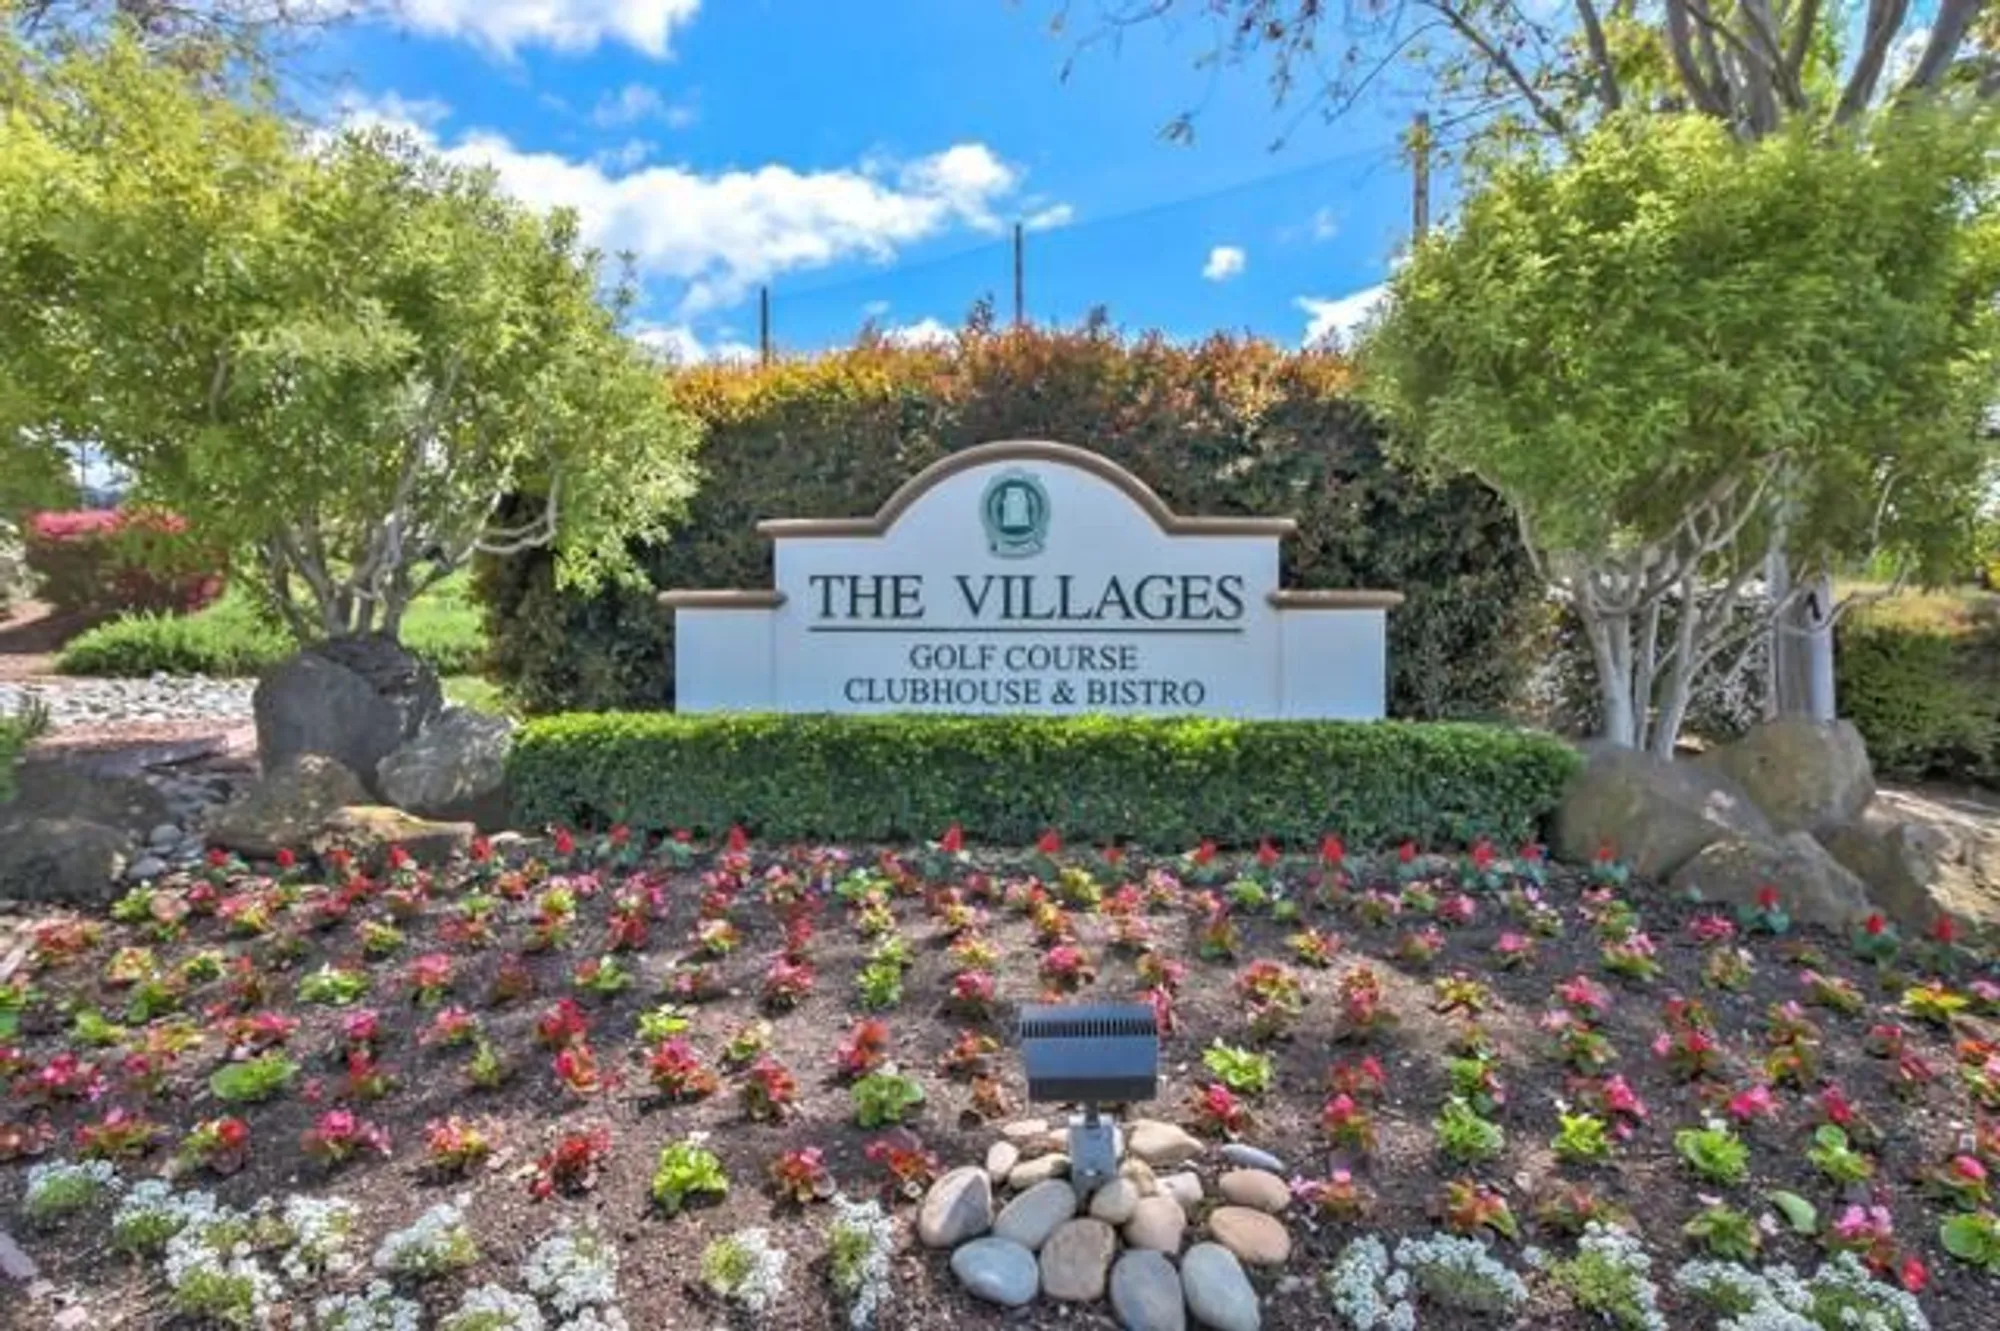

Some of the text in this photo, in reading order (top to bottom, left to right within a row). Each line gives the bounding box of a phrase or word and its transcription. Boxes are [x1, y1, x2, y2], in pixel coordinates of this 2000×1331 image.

[808, 573, 1245, 621] THE VILLAGES
[908, 643, 1139, 671] GOLF COURSE
[843, 676, 1207, 707] CLUBHOUSE & BISTRO
